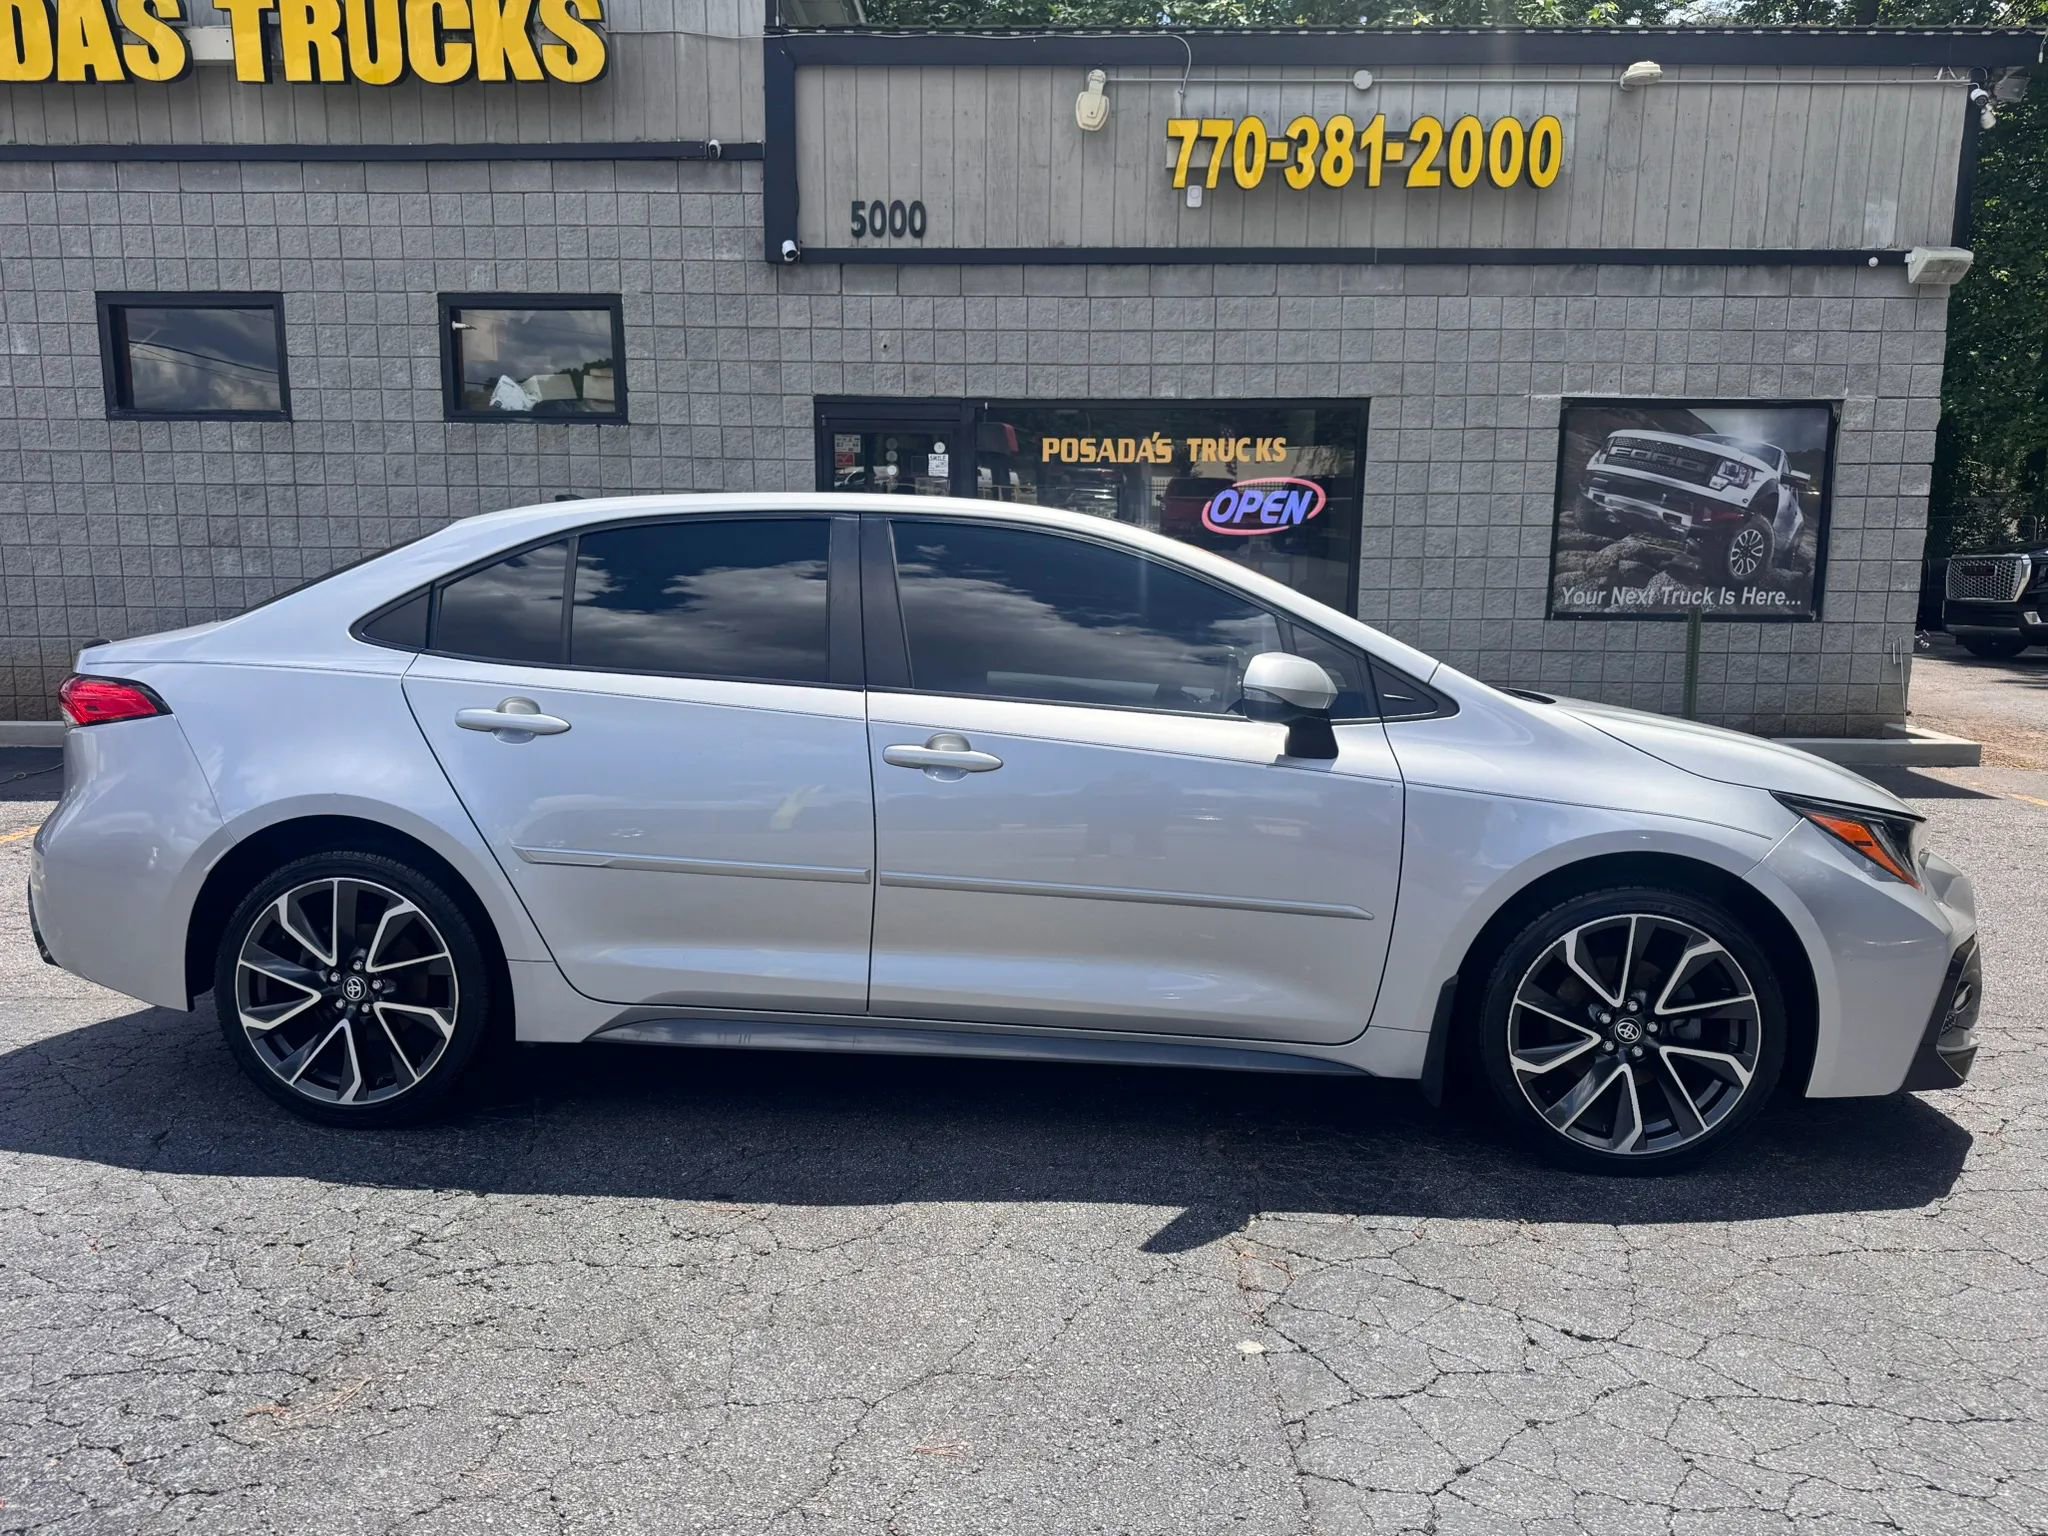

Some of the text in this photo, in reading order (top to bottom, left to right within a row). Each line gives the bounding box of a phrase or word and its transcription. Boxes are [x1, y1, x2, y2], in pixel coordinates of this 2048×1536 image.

[212, 0, 606, 85] TRUCKS
[1167, 113, 1563, 190] 770-381-2000
[851, 200, 927, 238] 5000
[1042, 432, 1173, 463] POSADA'S
[1209, 488, 1314, 525] OPEN
[1561, 586, 1802, 606] Your Next Truck Is Here...
